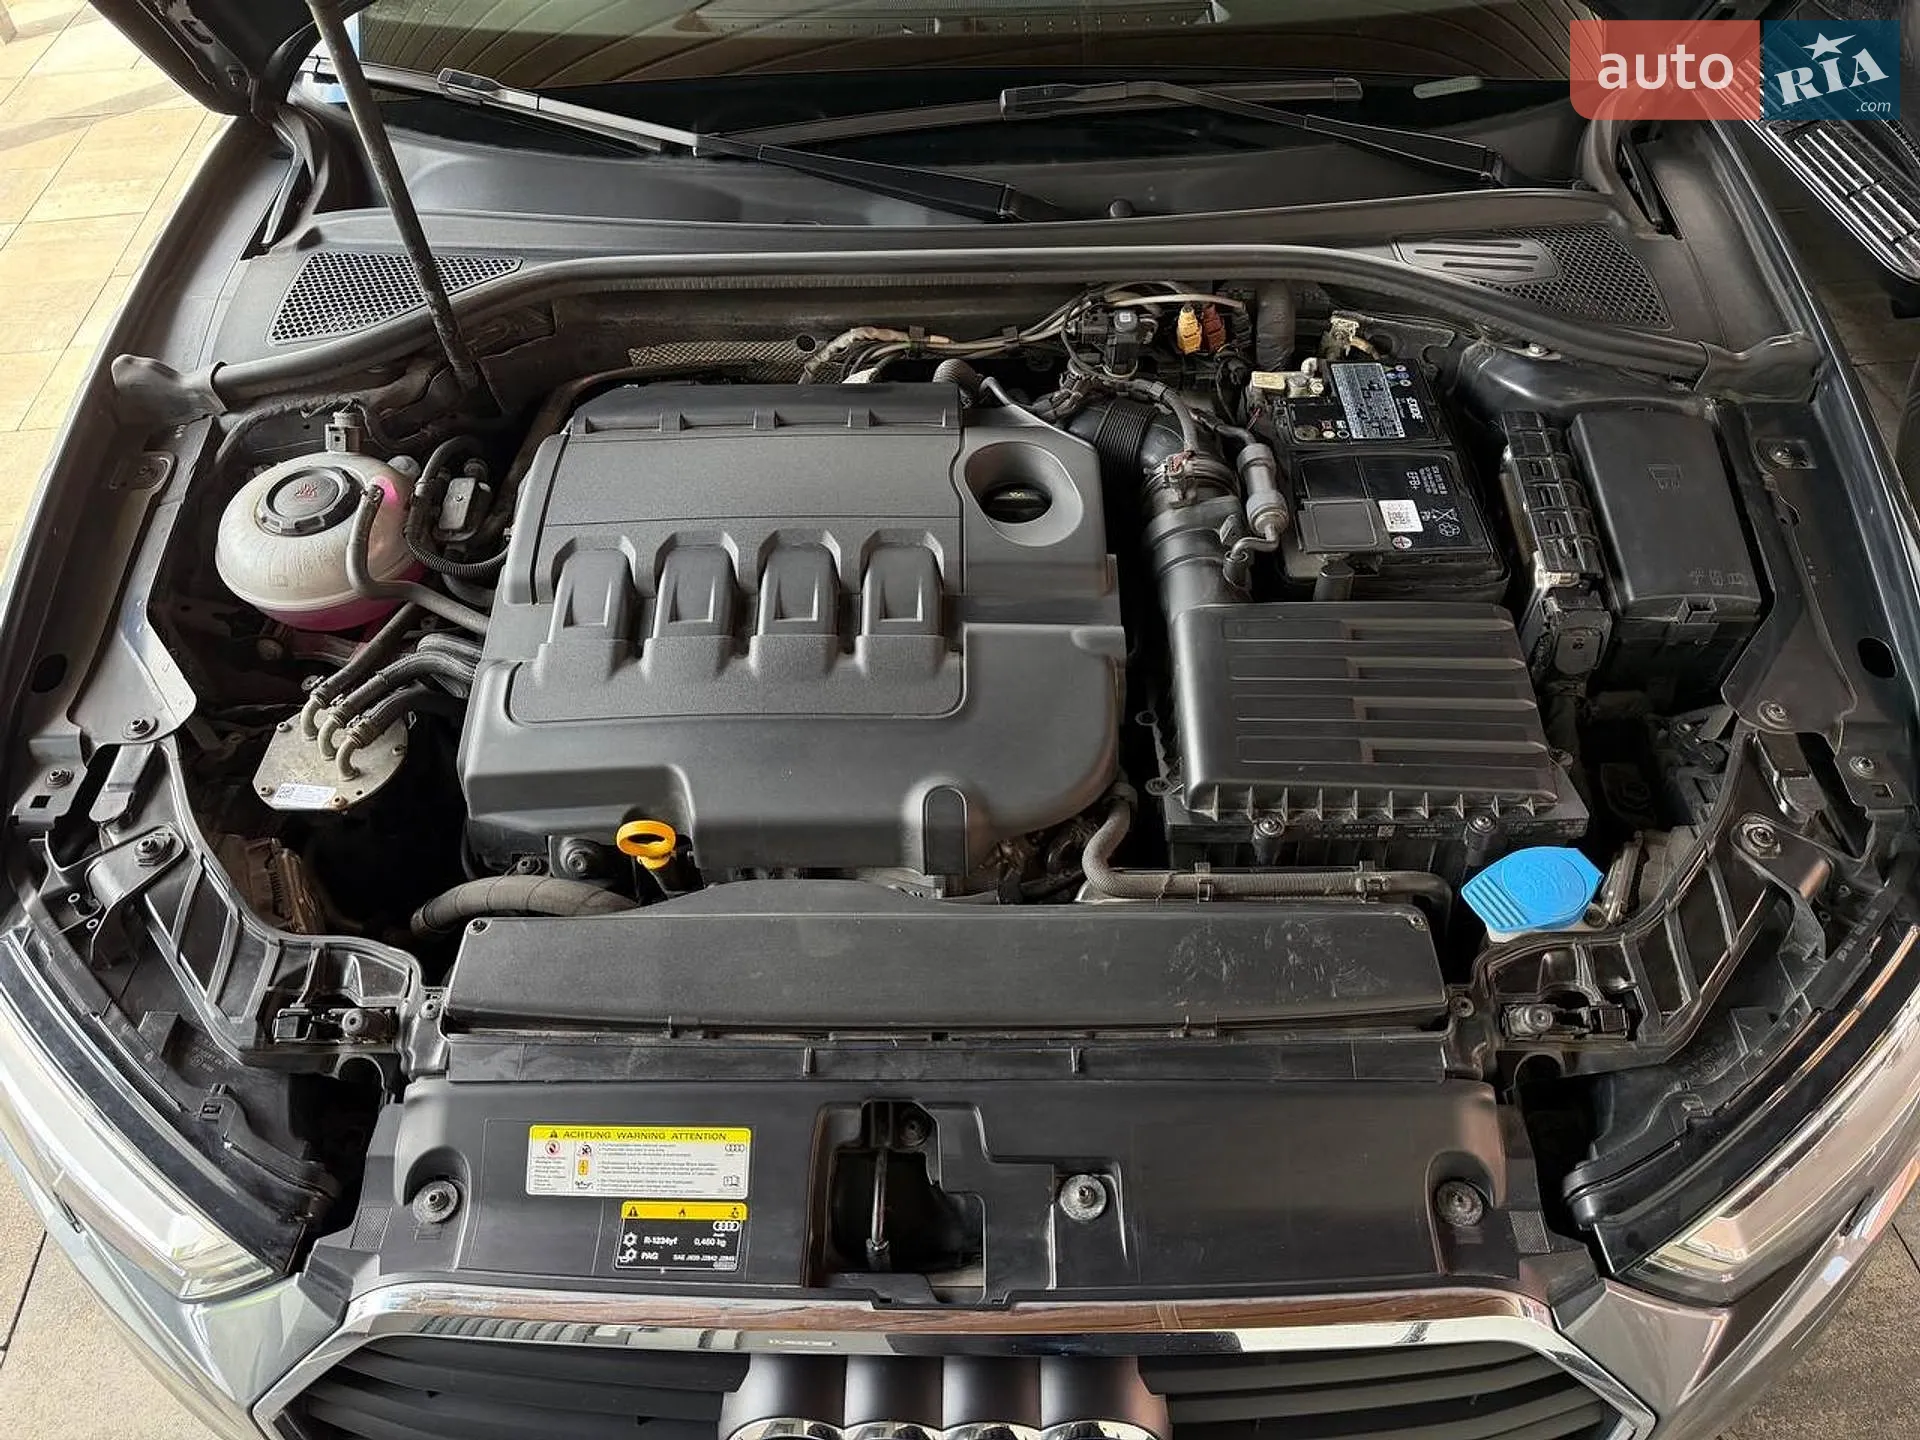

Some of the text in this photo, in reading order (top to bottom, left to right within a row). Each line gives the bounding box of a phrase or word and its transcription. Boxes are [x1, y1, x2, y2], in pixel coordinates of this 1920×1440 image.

[563, 1131, 727, 1141] ACHTUNG WARNING ATTENTION
[641, 1252, 659, 1260] PAG
